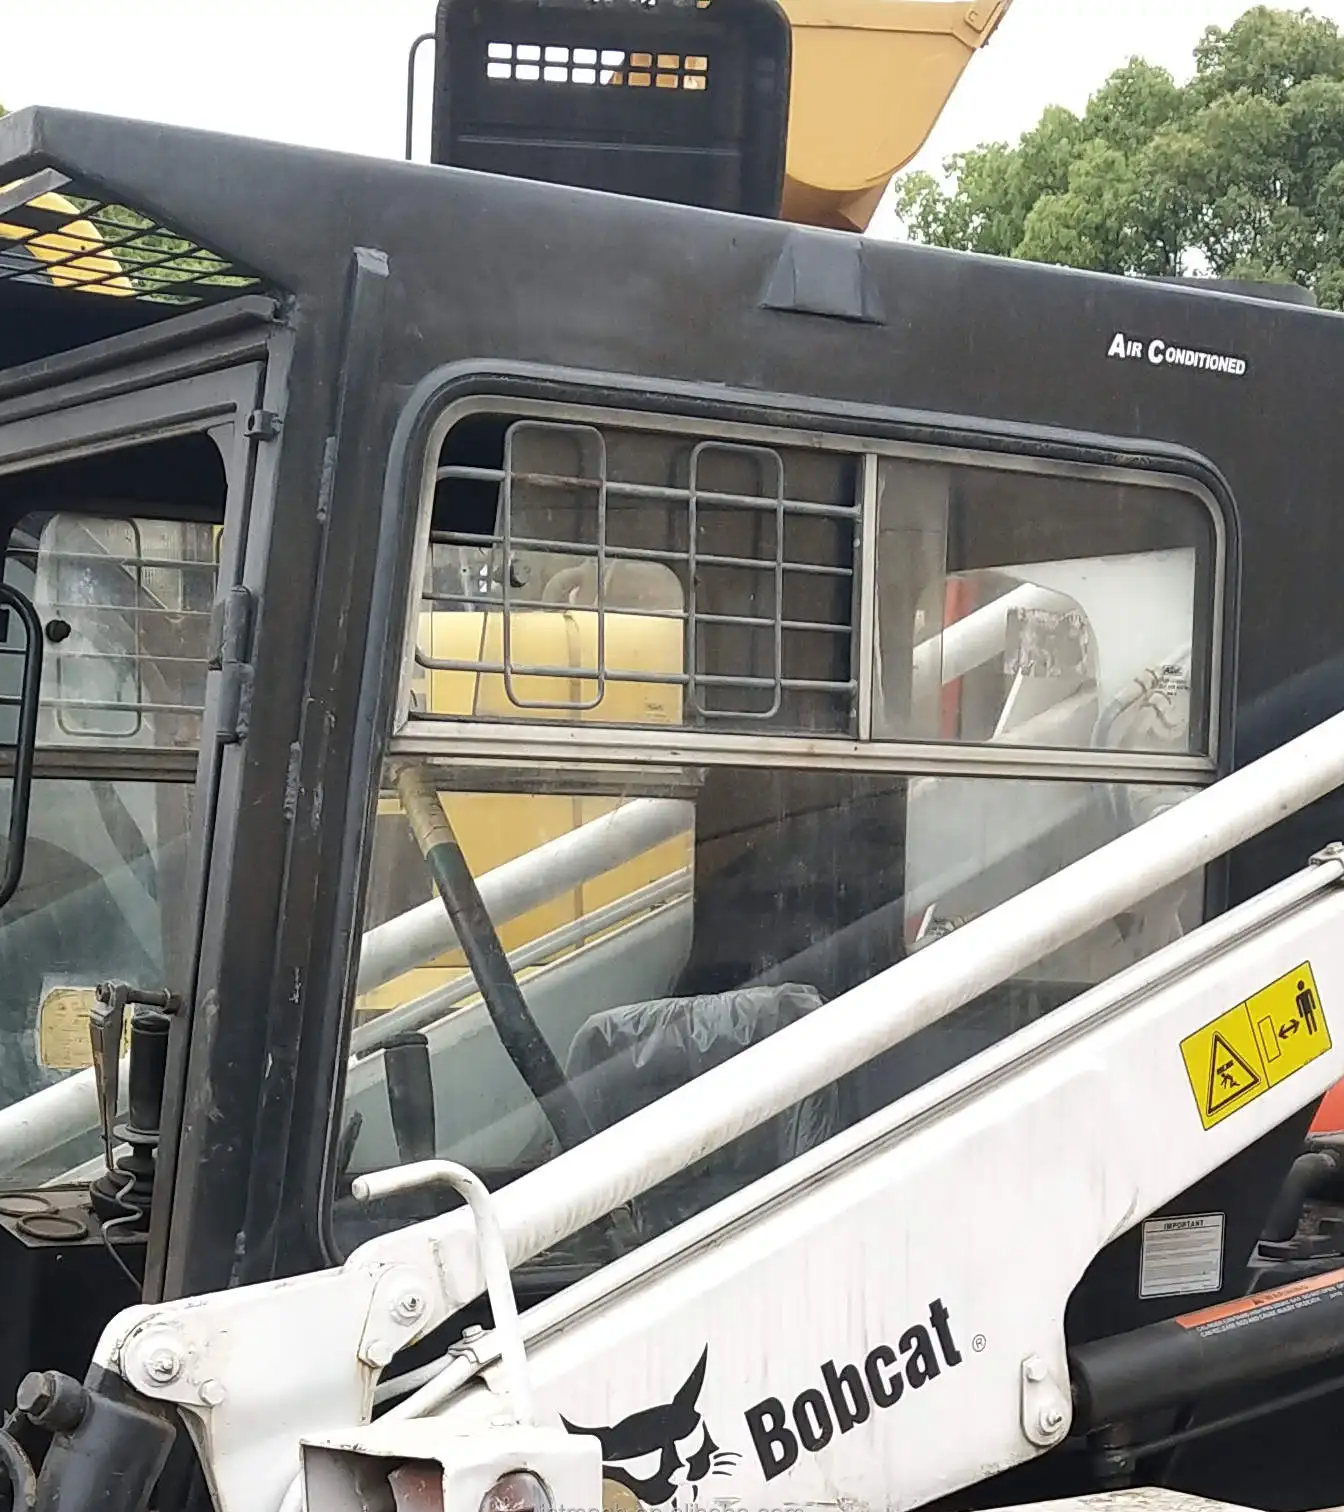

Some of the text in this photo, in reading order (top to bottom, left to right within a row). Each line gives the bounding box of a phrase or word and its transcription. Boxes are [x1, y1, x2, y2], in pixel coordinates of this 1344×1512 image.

[1107, 332, 1247, 376] AIR CONDITIONED
[743, 1297, 963, 1482] Bobcat
